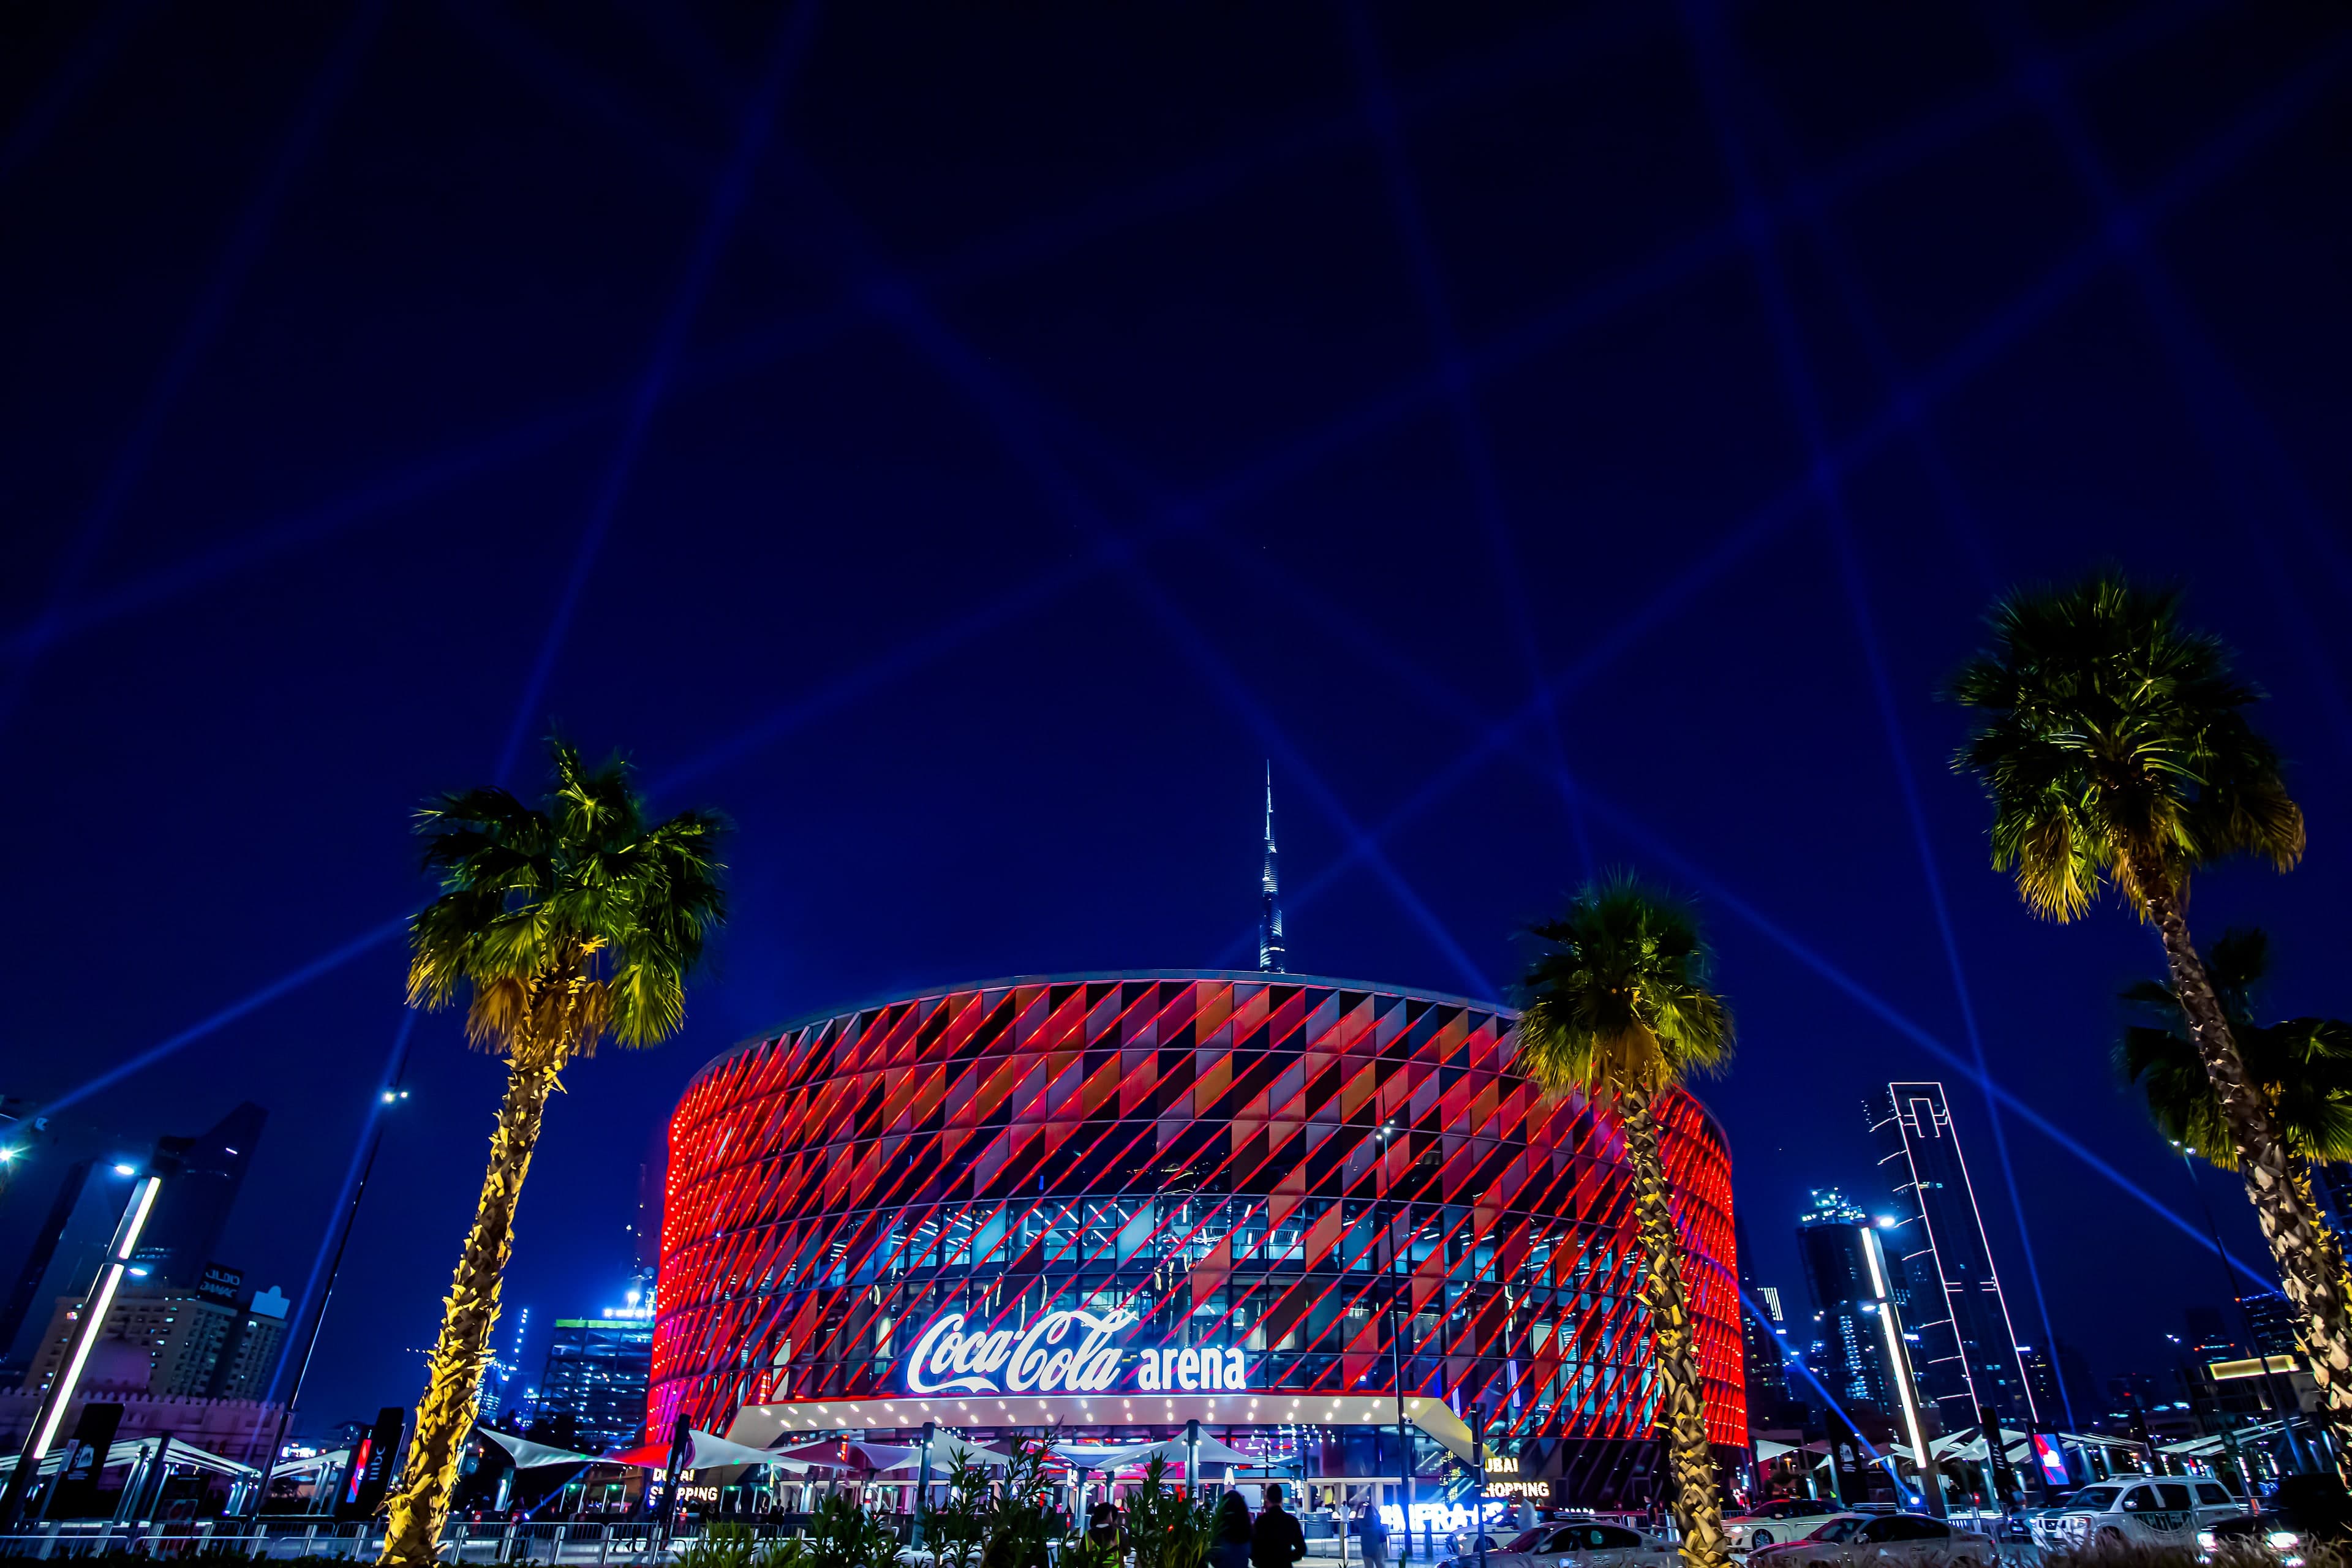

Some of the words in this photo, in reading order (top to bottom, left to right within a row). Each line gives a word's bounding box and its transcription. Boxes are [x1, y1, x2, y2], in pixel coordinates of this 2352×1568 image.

[906, 1310, 1139, 1393] Coca-Cola
[1139, 1348, 1246, 1390] arena
[369, 1446, 386, 1480] mbc
